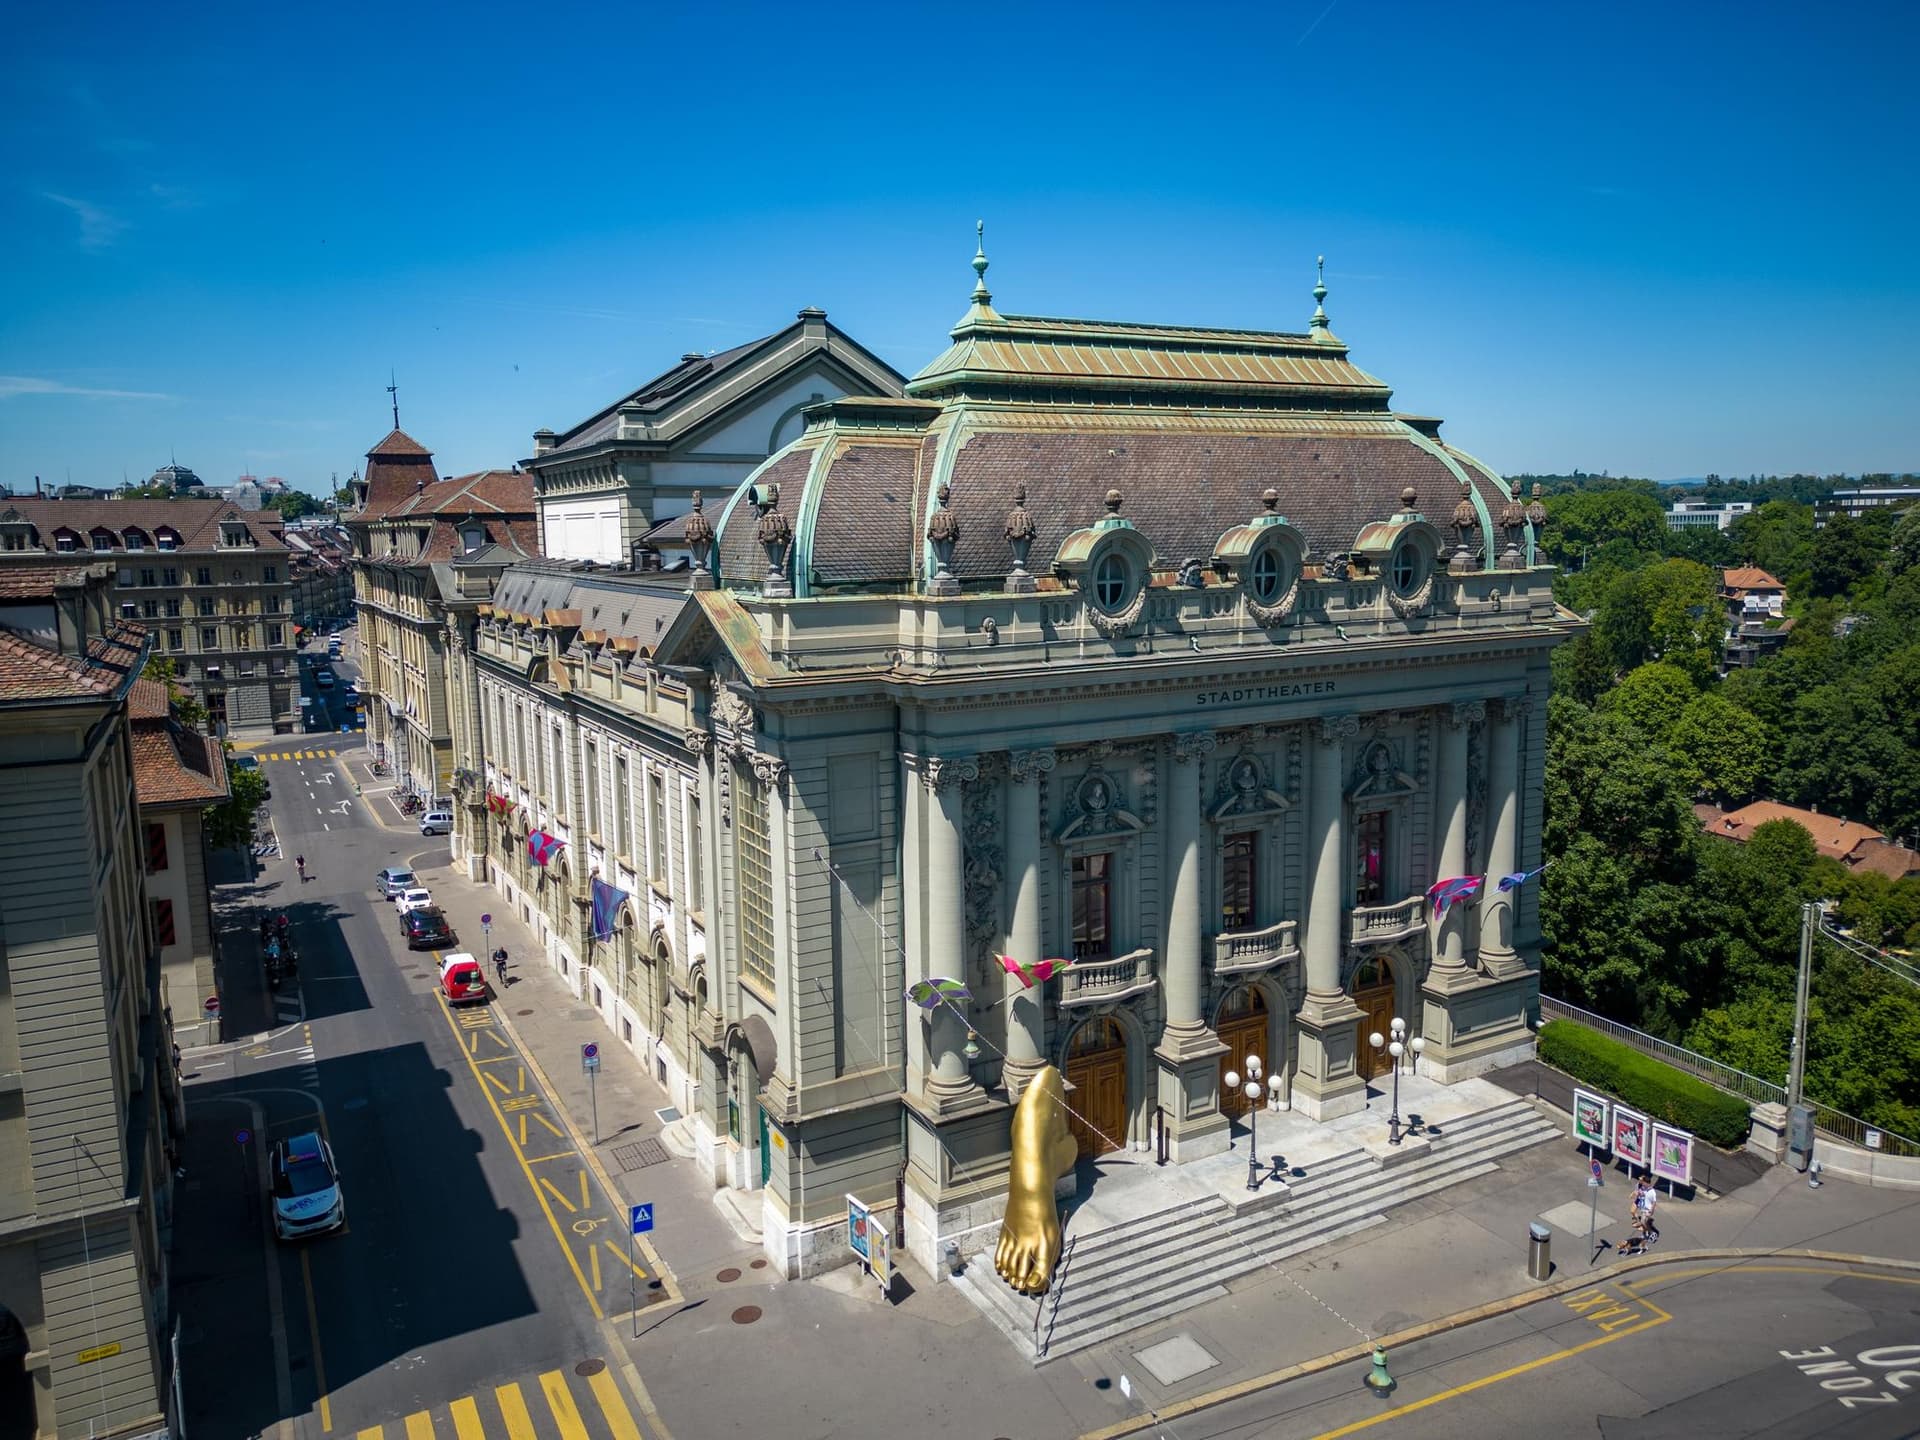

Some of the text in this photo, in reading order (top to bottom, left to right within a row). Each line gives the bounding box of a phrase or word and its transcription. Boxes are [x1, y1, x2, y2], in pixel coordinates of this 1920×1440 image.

[1196, 680, 1336, 705] STADTTHEATER
[1560, 1289, 1642, 1332] TAXI
[1778, 1345, 1900, 1409] ZONE
